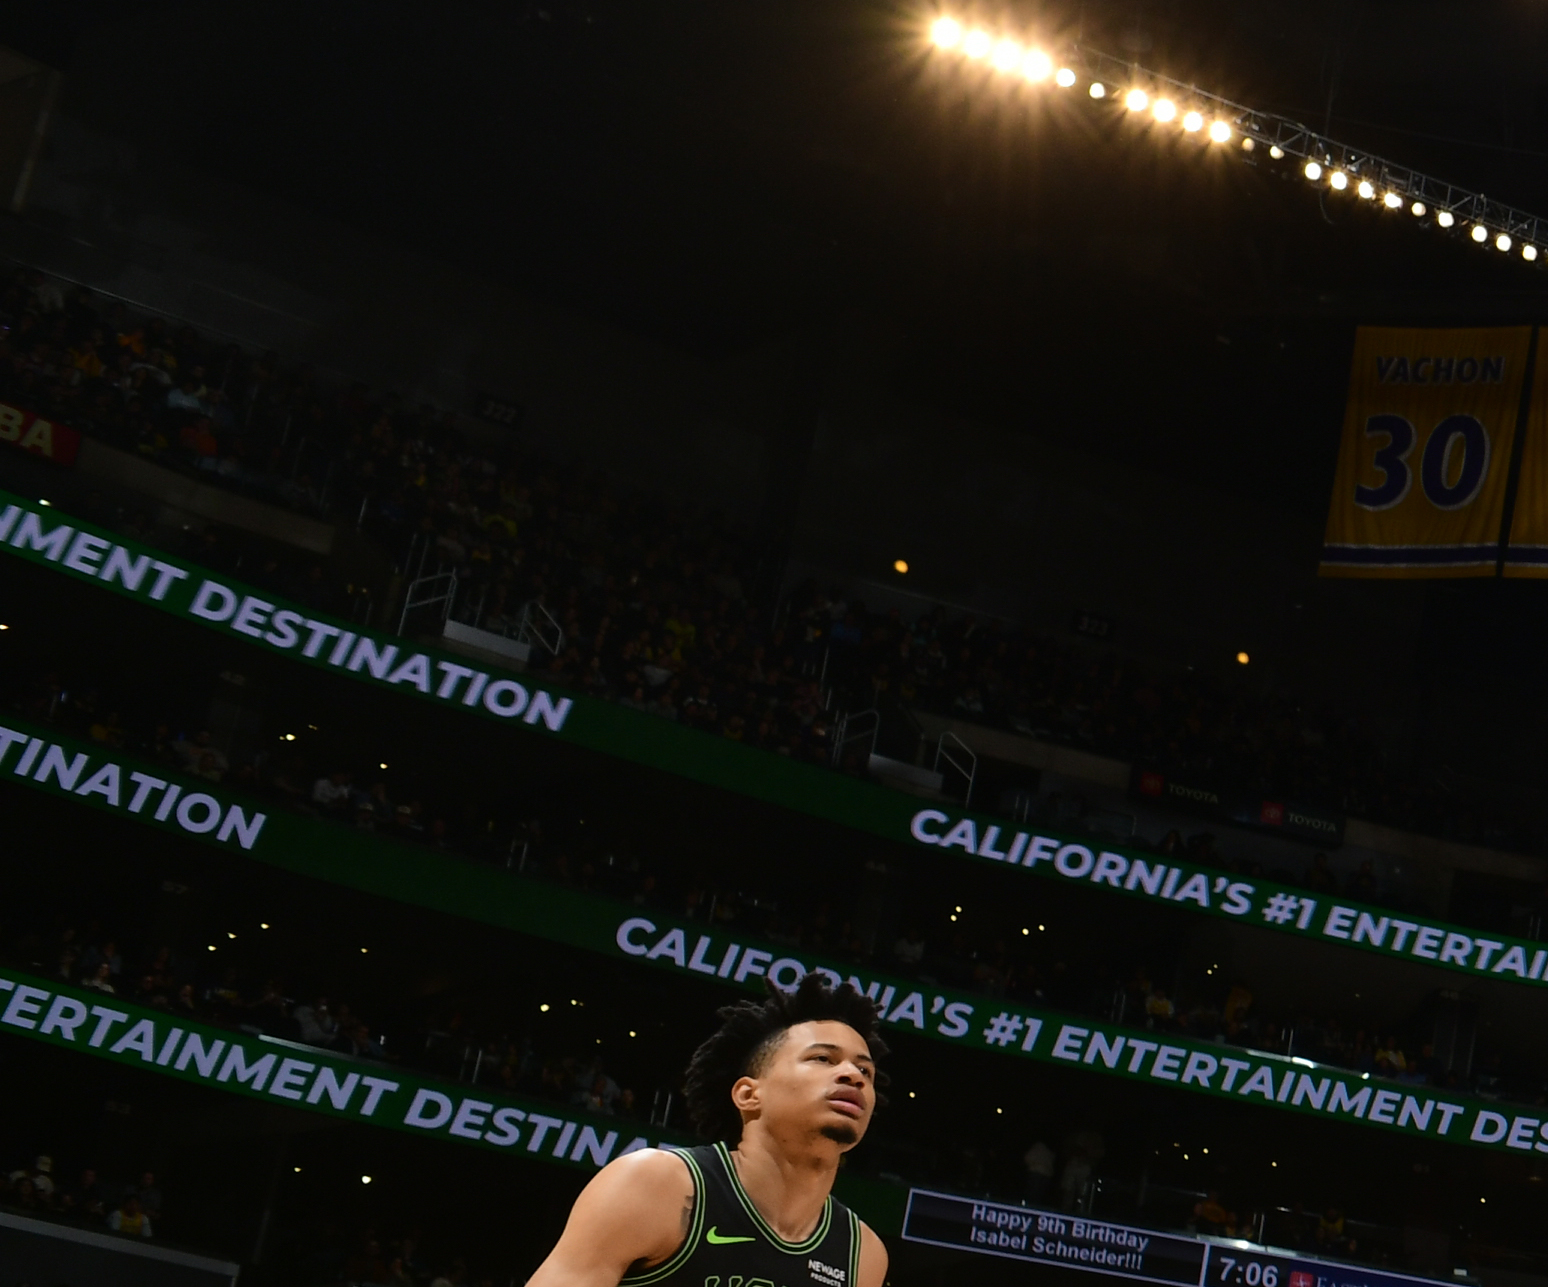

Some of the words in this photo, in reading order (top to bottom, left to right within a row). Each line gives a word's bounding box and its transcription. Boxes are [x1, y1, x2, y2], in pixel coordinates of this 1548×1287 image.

[1375, 356, 1506, 387] VACHON
[1353, 414, 1491, 512] 30
[190, 581, 572, 731] DESTINATION
[1168, 782, 1218, 806] TOYOTA
[1287, 813, 1337, 835] TOYOTA
[911, 810, 1253, 914] CALIFORNIA'S
[1262, 893, 1314, 929] #1
[983, 1013, 1042, 1051] #1
[1052, 1025, 1464, 1134] ENTERTAINMENT
[970, 1225, 1027, 1251] Isabel
[1032, 1235, 1144, 1271] Schneider!!!
[972, 1202, 1032, 1231] Happy
[1036, 1214, 1068, 1236] 9th
[1071, 1221, 1150, 1251] Birthday
[808, 1259, 847, 1282] NEWAGE
